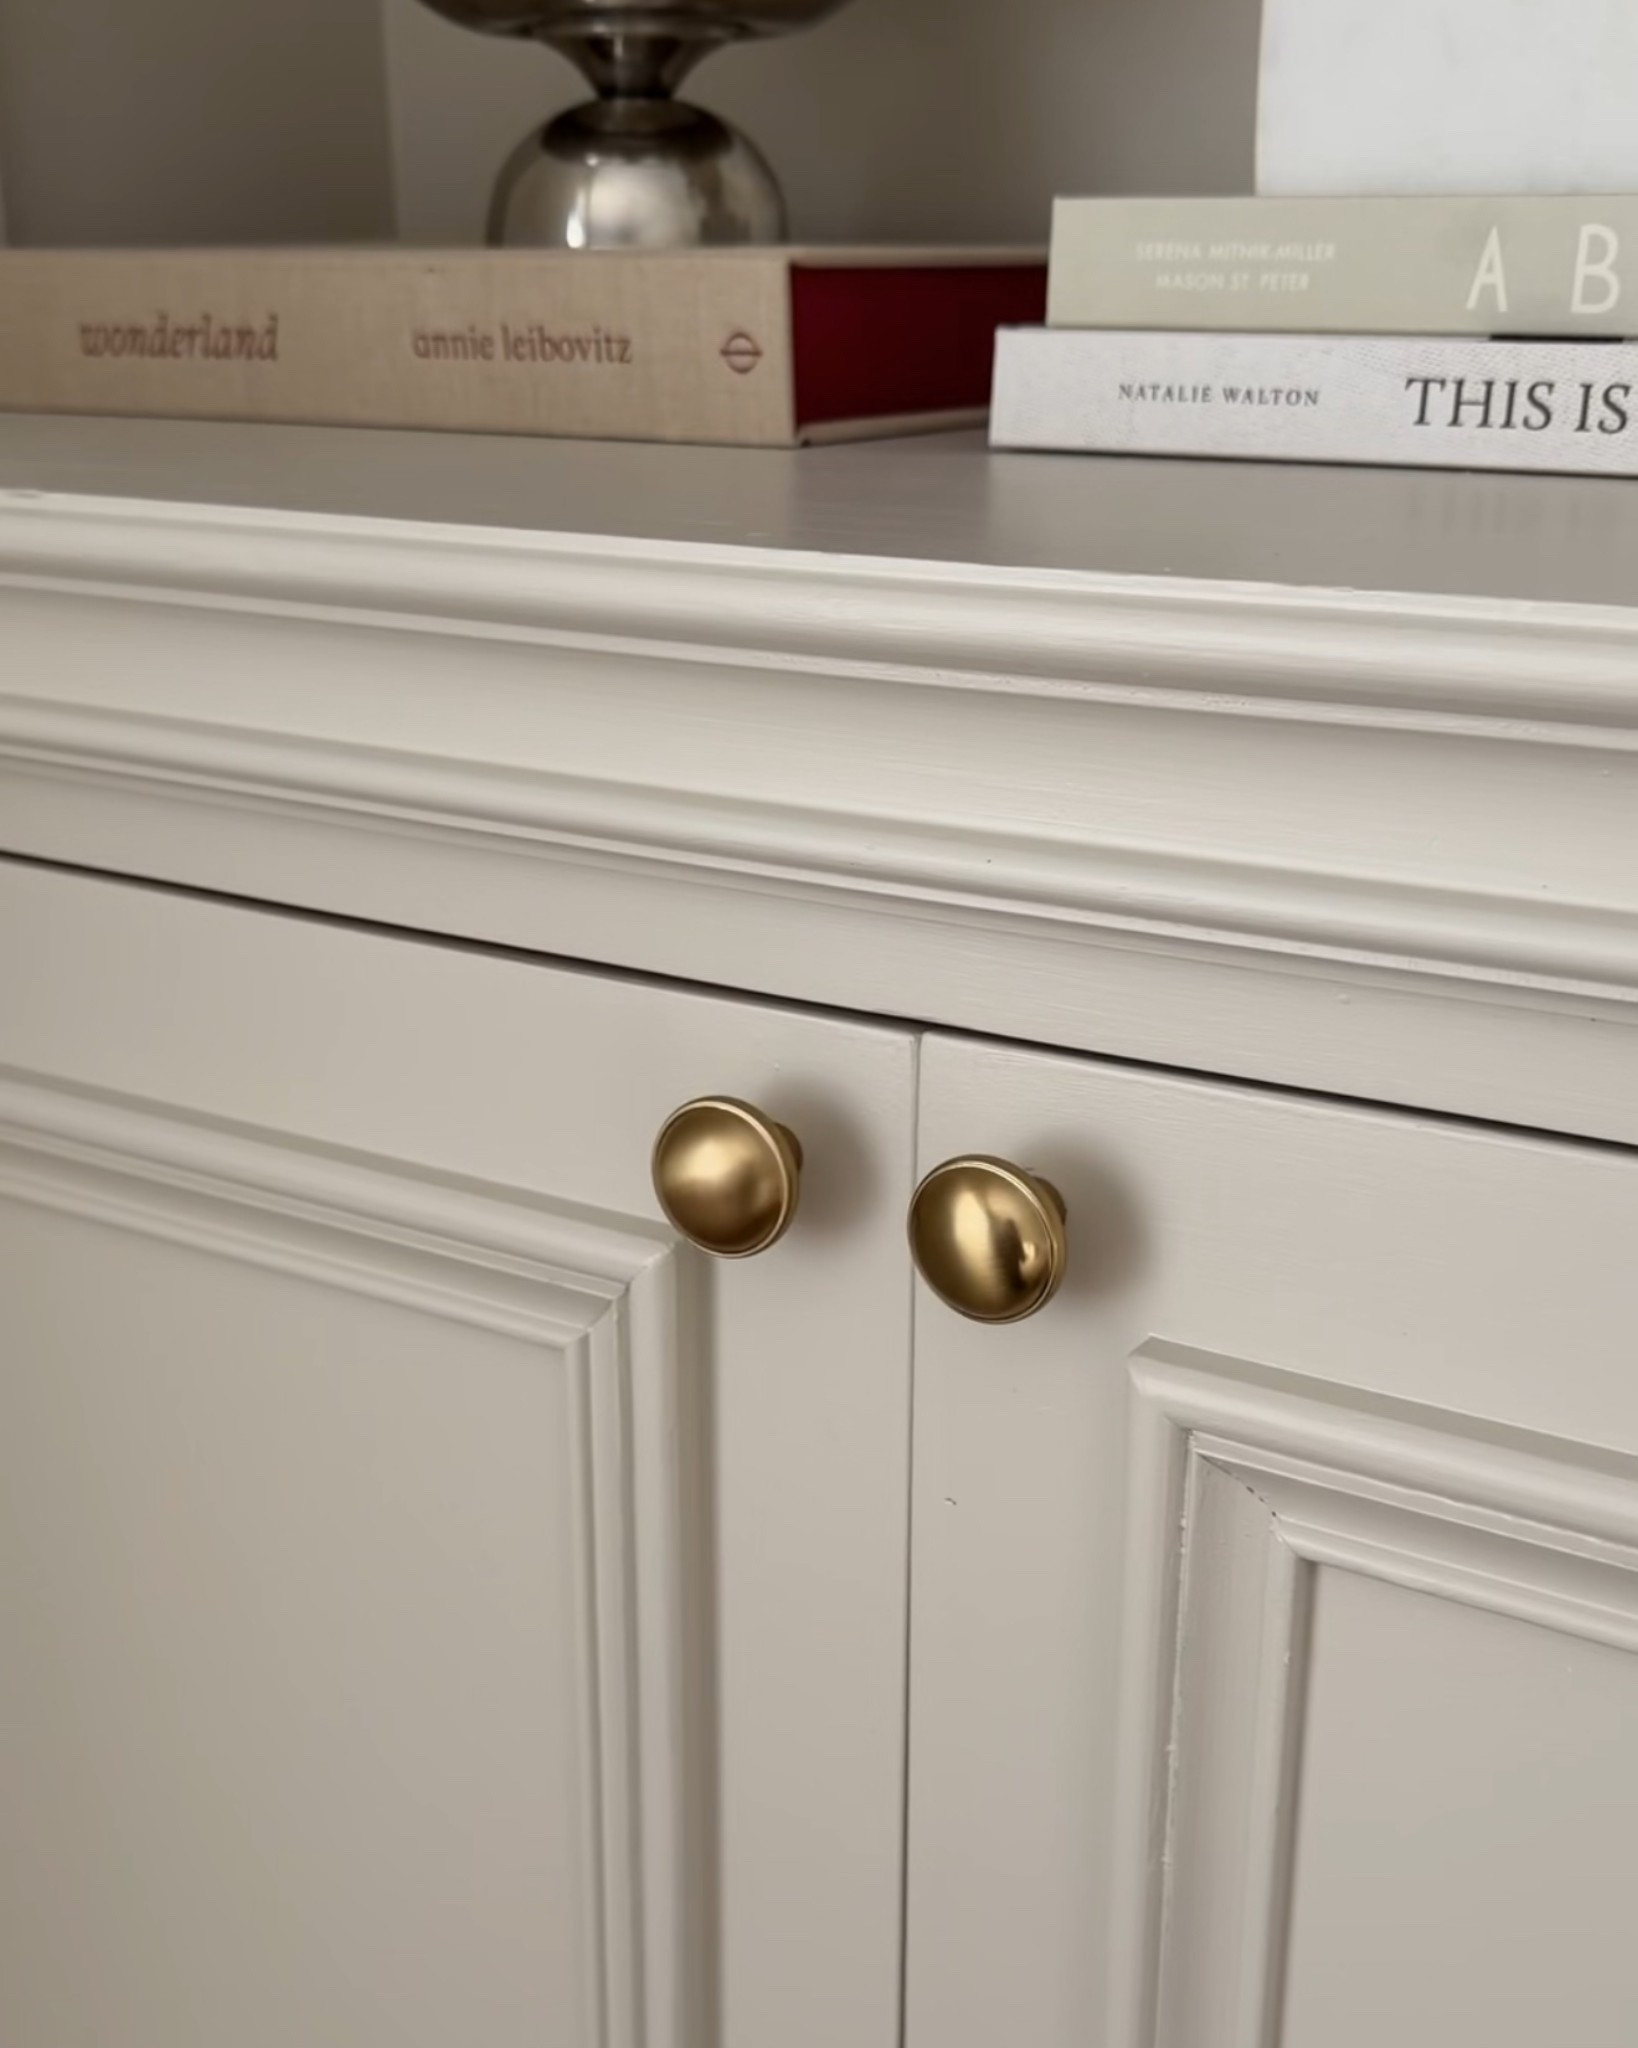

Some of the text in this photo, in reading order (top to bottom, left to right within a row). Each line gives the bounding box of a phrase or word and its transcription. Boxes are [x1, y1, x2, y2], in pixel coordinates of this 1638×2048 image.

[1136, 242, 1201, 261] SERENA
[1155, 272, 1225, 290] MASON
[1259, 272, 1309, 290] PETER
[80, 310, 279, 361] wonderland
[411, 322, 633, 364] annie leibovitz
[1118, 384, 1319, 406] NATALIE WALTON
[1405, 376, 1632, 434] THIS IS
